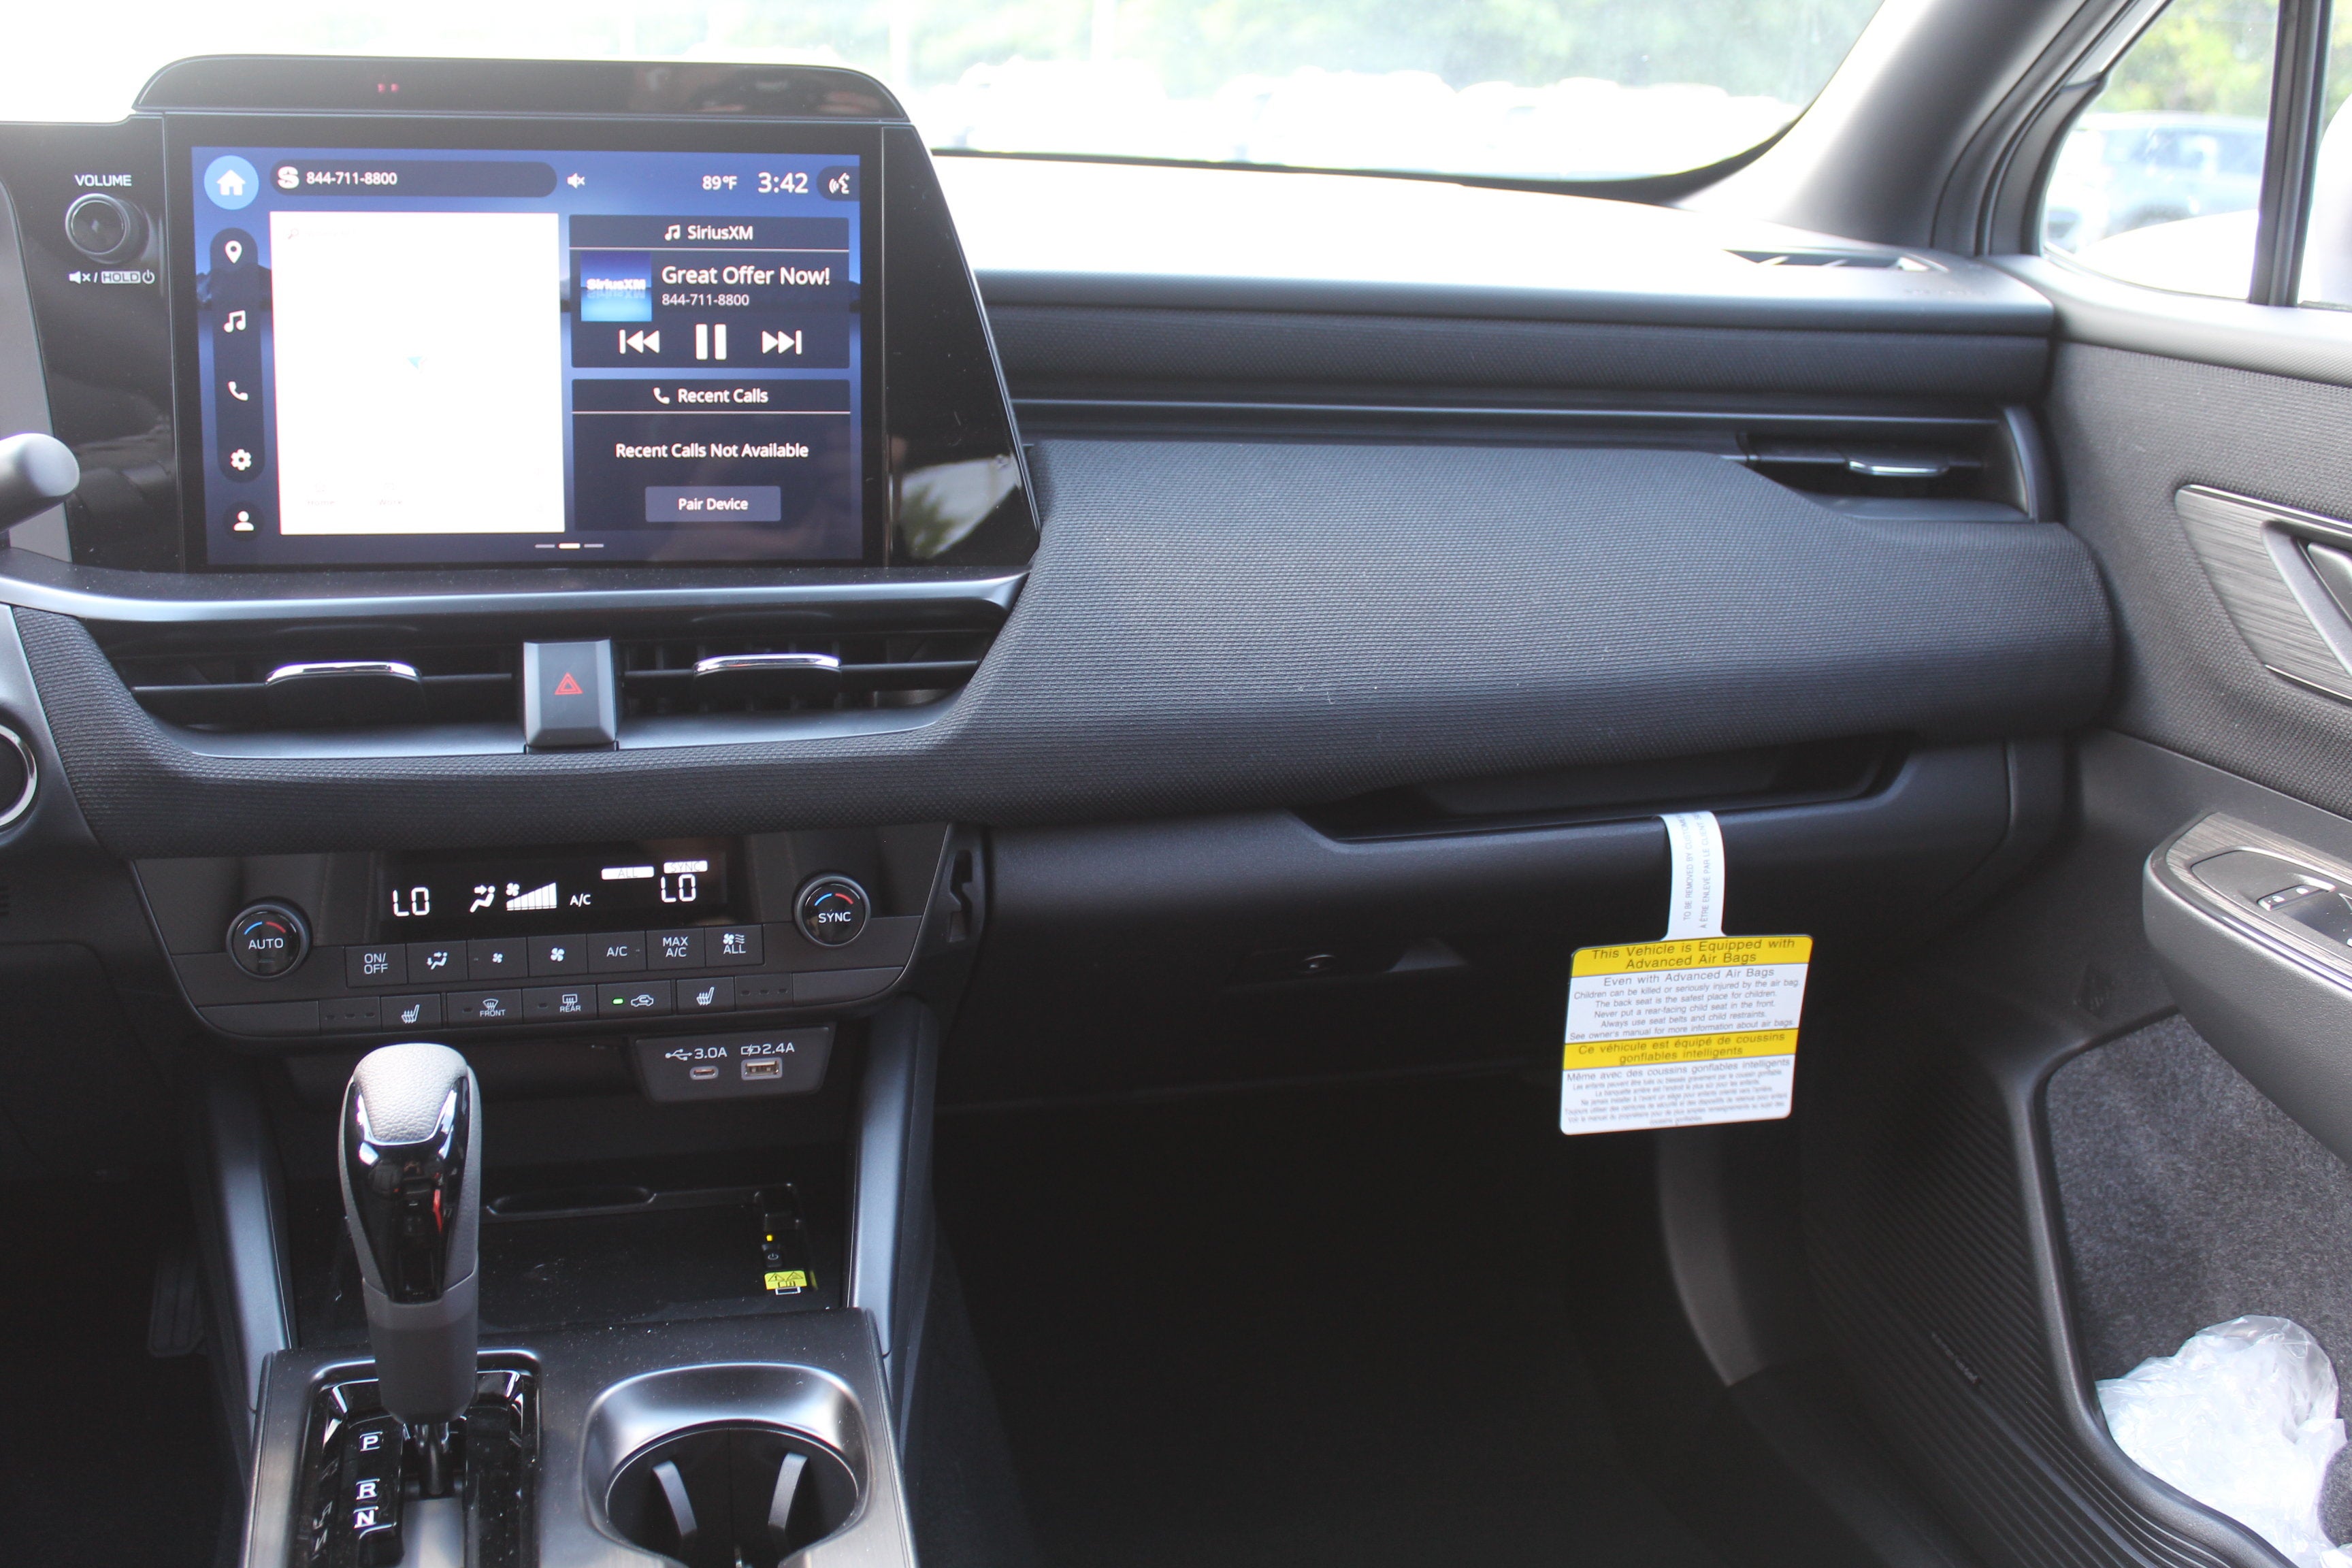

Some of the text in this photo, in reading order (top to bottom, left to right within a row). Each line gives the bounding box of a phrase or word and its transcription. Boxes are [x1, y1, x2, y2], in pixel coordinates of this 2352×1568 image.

[75, 174, 132, 187] VOLUME
[306, 172, 398, 185] 844-711-8800
[757, 172, 808, 193] 3:42
[687, 225, 753, 241] SiriusXM
[103, 272, 139, 282] HOLD
[662, 266, 830, 286] Great Offer Now!
[586, 278, 647, 290] SiriusXM
[662, 293, 749, 306] 844-711-8800
[678, 388, 769, 403] Recent Calls
[615, 443, 809, 458] Recent Calls Not Available
[679, 498, 749, 511] Pair Device
[1697, 821, 1708, 846] CLIENT
[1686, 853, 1693, 862] BY
[1702, 848, 1710, 857] LE
[617, 868, 638, 878] ALL
[670, 862, 701, 872] SYNC
[1685, 864, 1694, 898] REMOVED
[570, 894, 591, 906] A/C
[1684, 900, 1693, 909] BE
[817, 912, 851, 924] SYNC
[1683, 911, 1691, 921] TO
[248, 938, 284, 949] AUTO
[662, 936, 689, 947] MAX
[606, 946, 628, 957] A/C
[665, 947, 687, 958] A/C
[723, 943, 747, 955] ALL
[1592, 938, 1795, 960] This Vehicle is Equipped with
[364, 953, 386, 964] ON/
[1626, 952, 1757, 970] Advanced Air Bags
[363, 963, 389, 975] OFF
[1603, 968, 1775, 987] Even with Advanced Air Bags
[1573, 990, 1607, 1000] Children
[1627, 987, 1638, 996] be
[1641, 985, 1661, 995] killed
[1675, 982, 1710, 993] seriously
[1713, 981, 1740, 992] injured
[1742, 980, 1752, 989] by
[1754, 979, 1767, 987] the
[1770, 979, 1781, 987] air
[1595, 990, 1777, 1009] The back seat is the safest place for children.
[479, 1009, 506, 1017] FRONT
[559, 1004, 581, 1013] REAR
[1594, 1010, 1618, 1019] Never
[1620, 1009, 1634, 1018] put
[1645, 1006, 1686, 1016] rear-facing
[1689, 1003, 1708, 1012] child
[1711, 1002, 1728, 1011] seat
[1731, 1000, 1737, 1009] in
[1741, 1000, 1753, 1009] the
[1756, 999, 1776, 1008] front.
[1601, 1019, 1629, 1029] Always
[1649, 1017, 1666, 1026] seat
[1669, 1015, 1687, 1024] belts
[1690, 1014, 1705, 1022] and
[1708, 1011, 1727, 1021] child
[1729, 1010, 1766, 1019] restraints.
[1569, 1032, 1586, 1041] See
[1588, 1030, 1620, 1039] owner's
[1622, 1028, 1652, 1037] manual
[1654, 1026, 1665, 1034] for
[1668, 1026, 1688, 1034] more
[1690, 1022, 1733, 1032] information
[1736, 1020, 1758, 1029] about
[1761, 1019, 1771, 1028] air
[762, 1043, 795, 1054] 2.4A
[1578, 1032, 1786, 1055] Ce véhicule est équipé de coussins
[693, 1047, 728, 1059] 3.0A
[1620, 1047, 1744, 1066] gonflables intelligents
[1567, 1072, 1597, 1082] Même
[1600, 1071, 1623, 1080] avec
[1627, 1068, 1644, 1078] des
[1647, 1066, 1688, 1077] coussins
[1691, 1062, 1738, 1075] gonflables
[1742, 1058, 1791, 1071] intelligents
[362, 1435, 379, 1450] P
[359, 1482, 377, 1499] R
[357, 1509, 375, 1526] N
